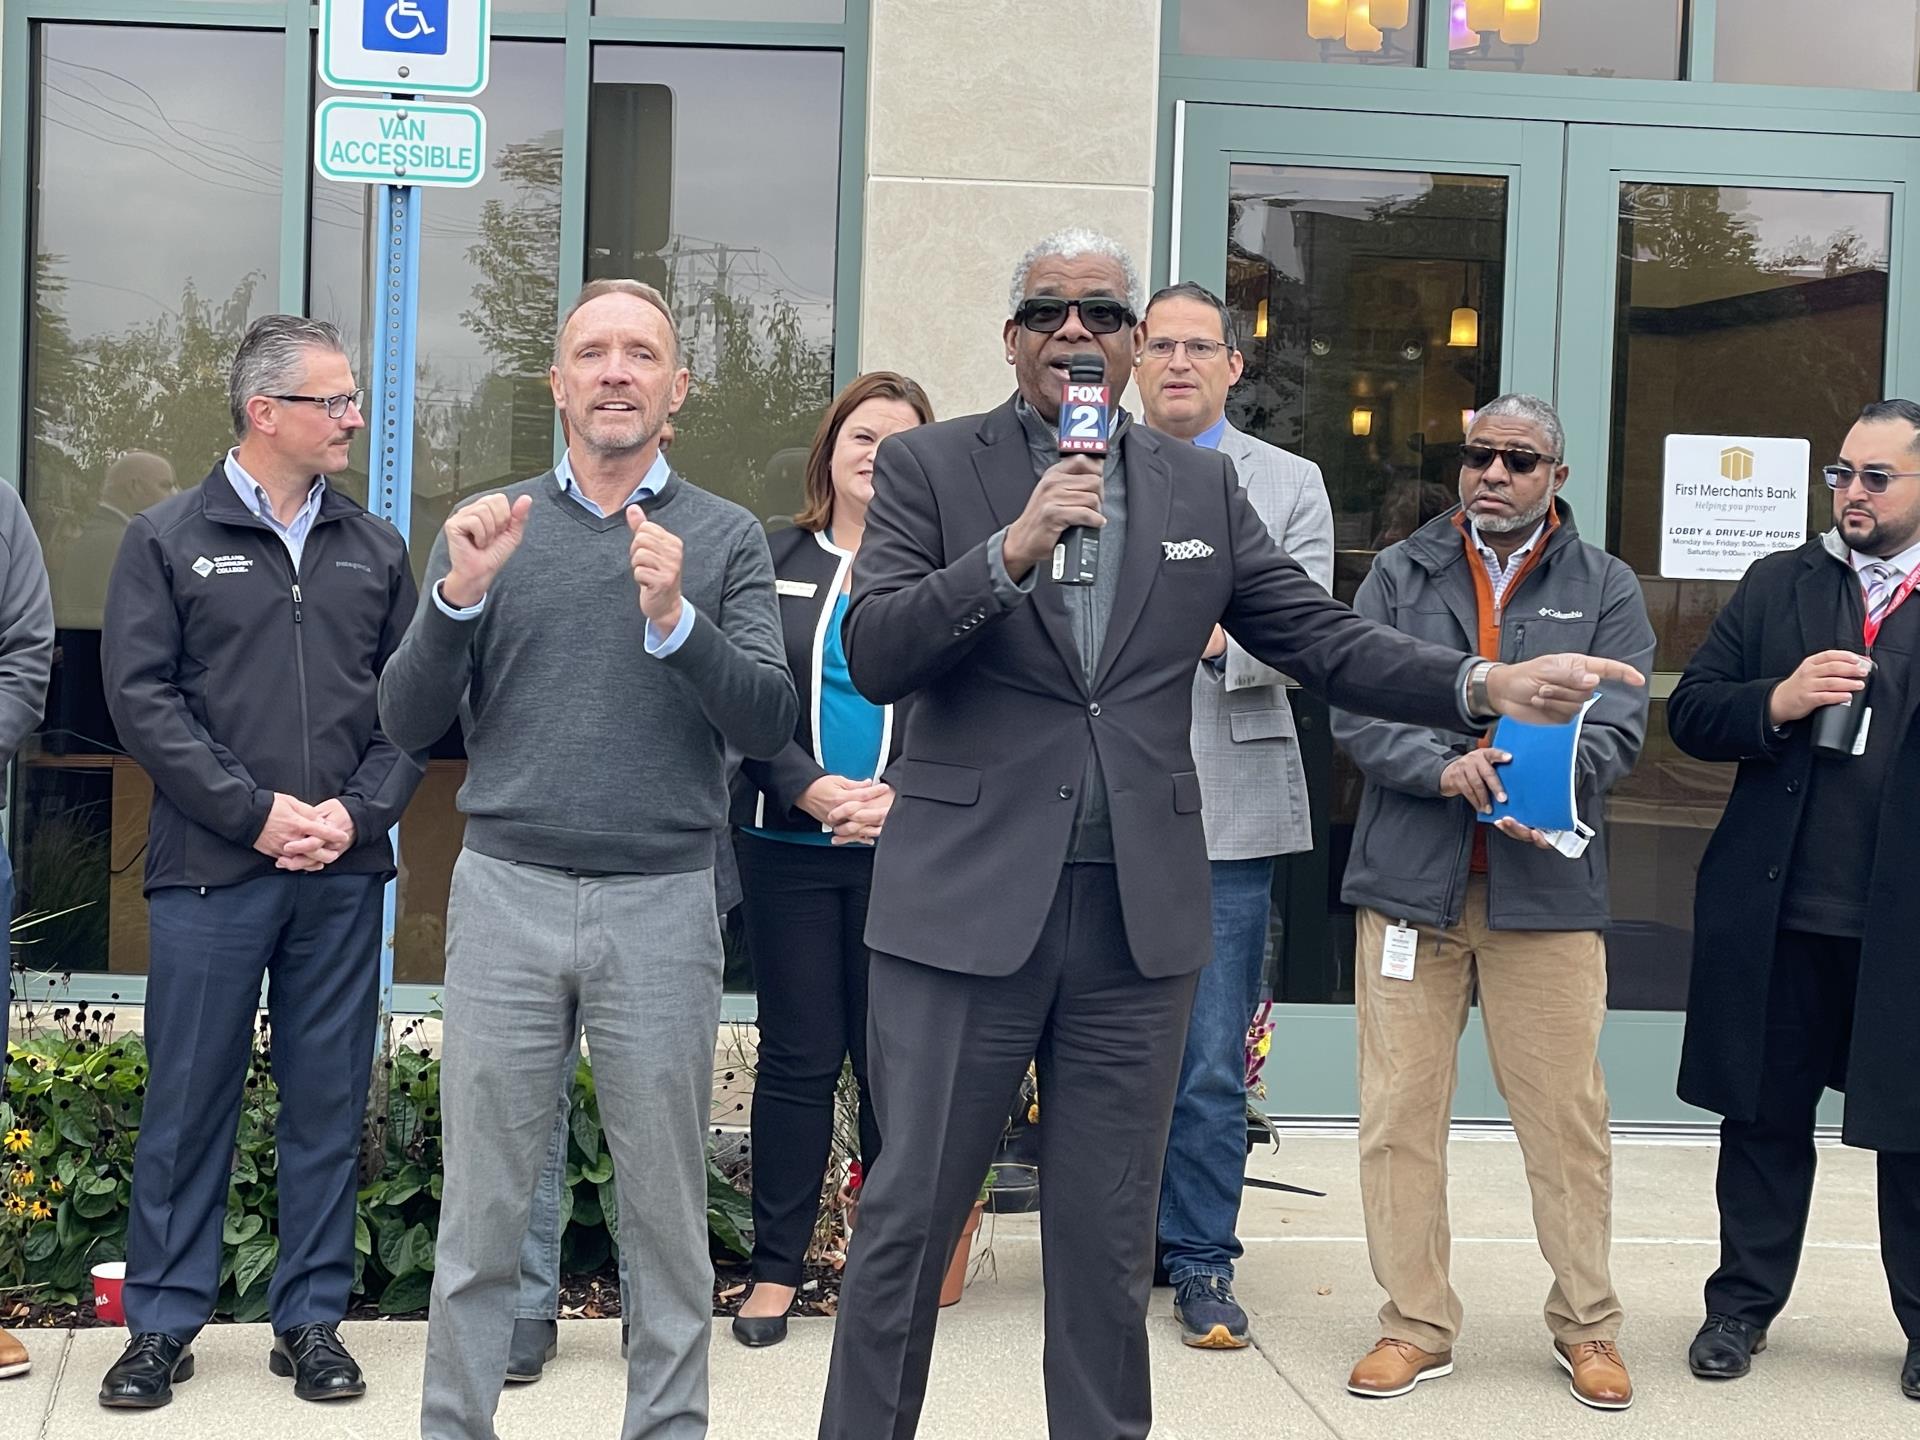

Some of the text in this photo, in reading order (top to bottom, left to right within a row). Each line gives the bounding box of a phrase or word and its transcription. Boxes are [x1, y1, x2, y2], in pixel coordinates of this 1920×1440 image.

[379, 117, 426, 141] VAN
[329, 140, 473, 169] ACCESSIBLE
[1068, 385, 1105, 403] FOX
[1070, 405, 1099, 438] 2
[1062, 440, 1104, 450] NEWS
[1675, 483, 1797, 499] First Merchants Bank
[1695, 500, 1777, 513] Helping you prosper
[1669, 527, 1703, 536] LOBBY
[1715, 528, 1763, 538] DRIVE-UP
[1765, 530, 1801, 539] HOURS
[1672, 538, 1701, 547] Monday
[1547, 608, 1583, 619] Columbia
